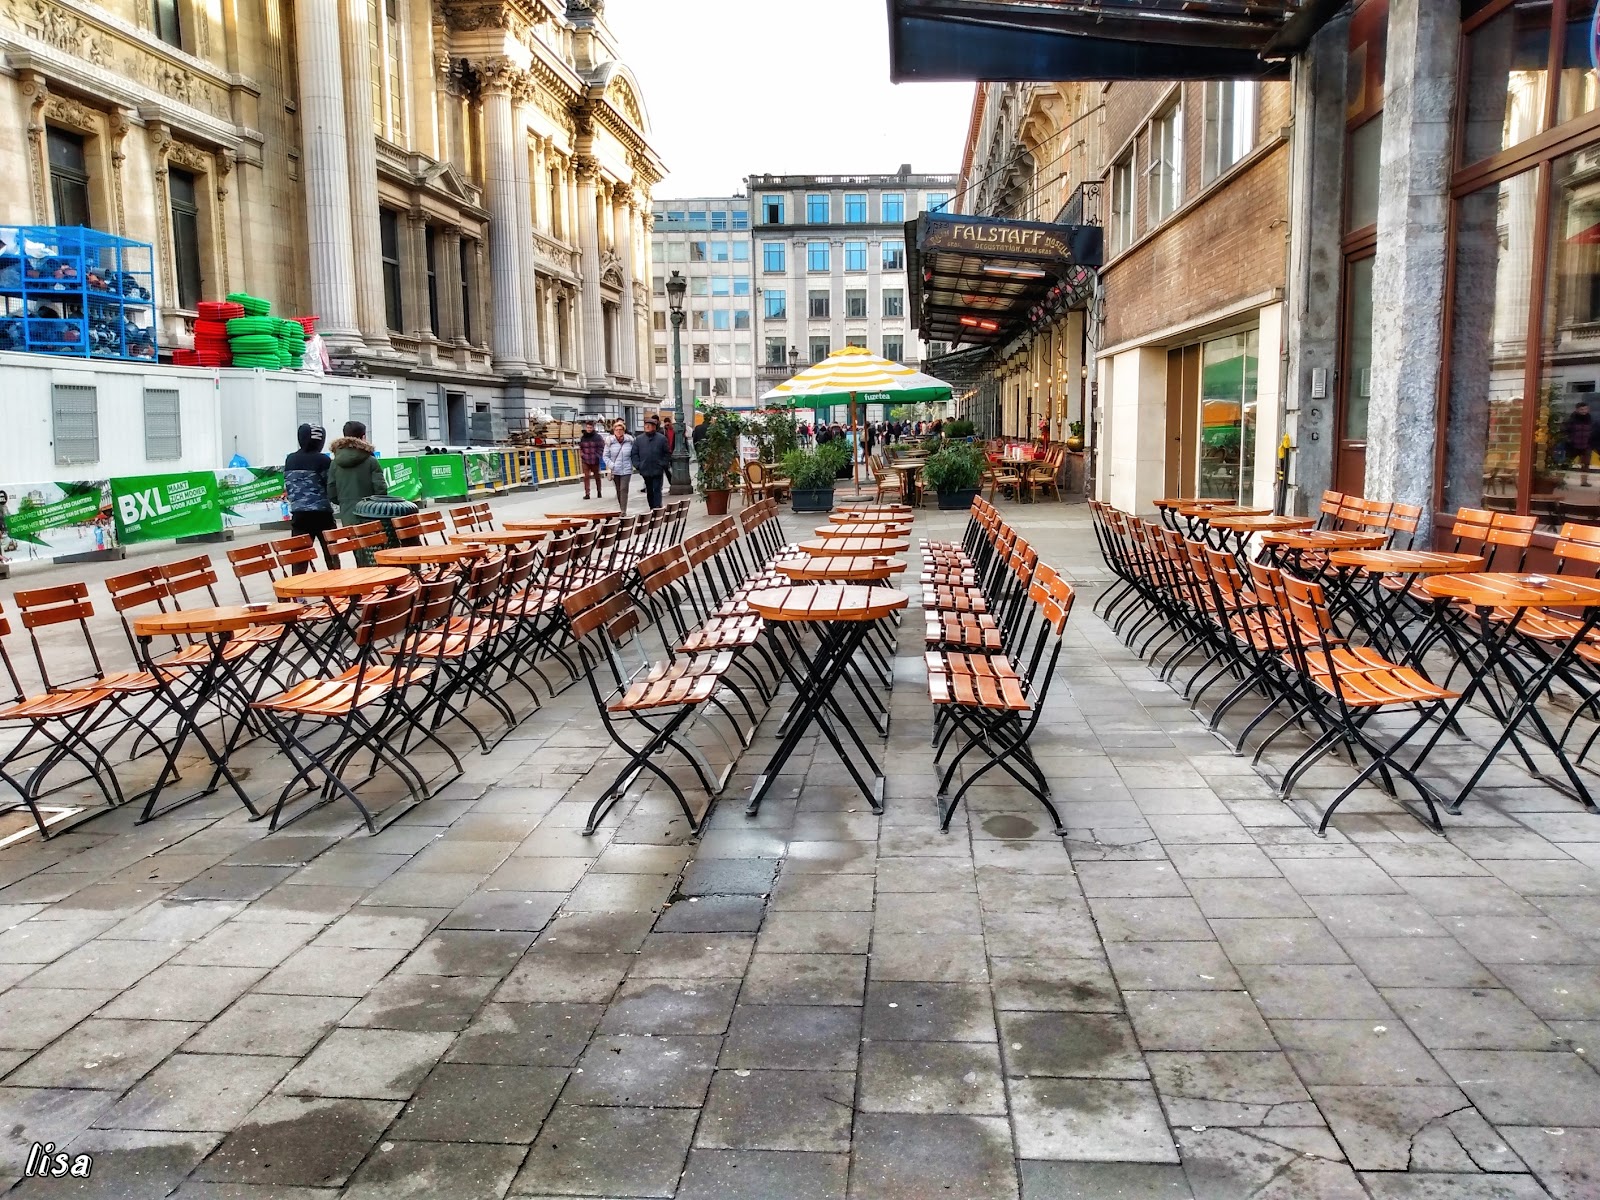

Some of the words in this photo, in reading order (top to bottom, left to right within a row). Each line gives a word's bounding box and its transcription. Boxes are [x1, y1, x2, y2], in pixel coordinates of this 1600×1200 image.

[953, 225, 1046, 246] FALSTAFF
[864, 393, 891, 401] fuzetea
[168, 481, 188, 493] MAAKT
[117, 487, 172, 526] BXL
